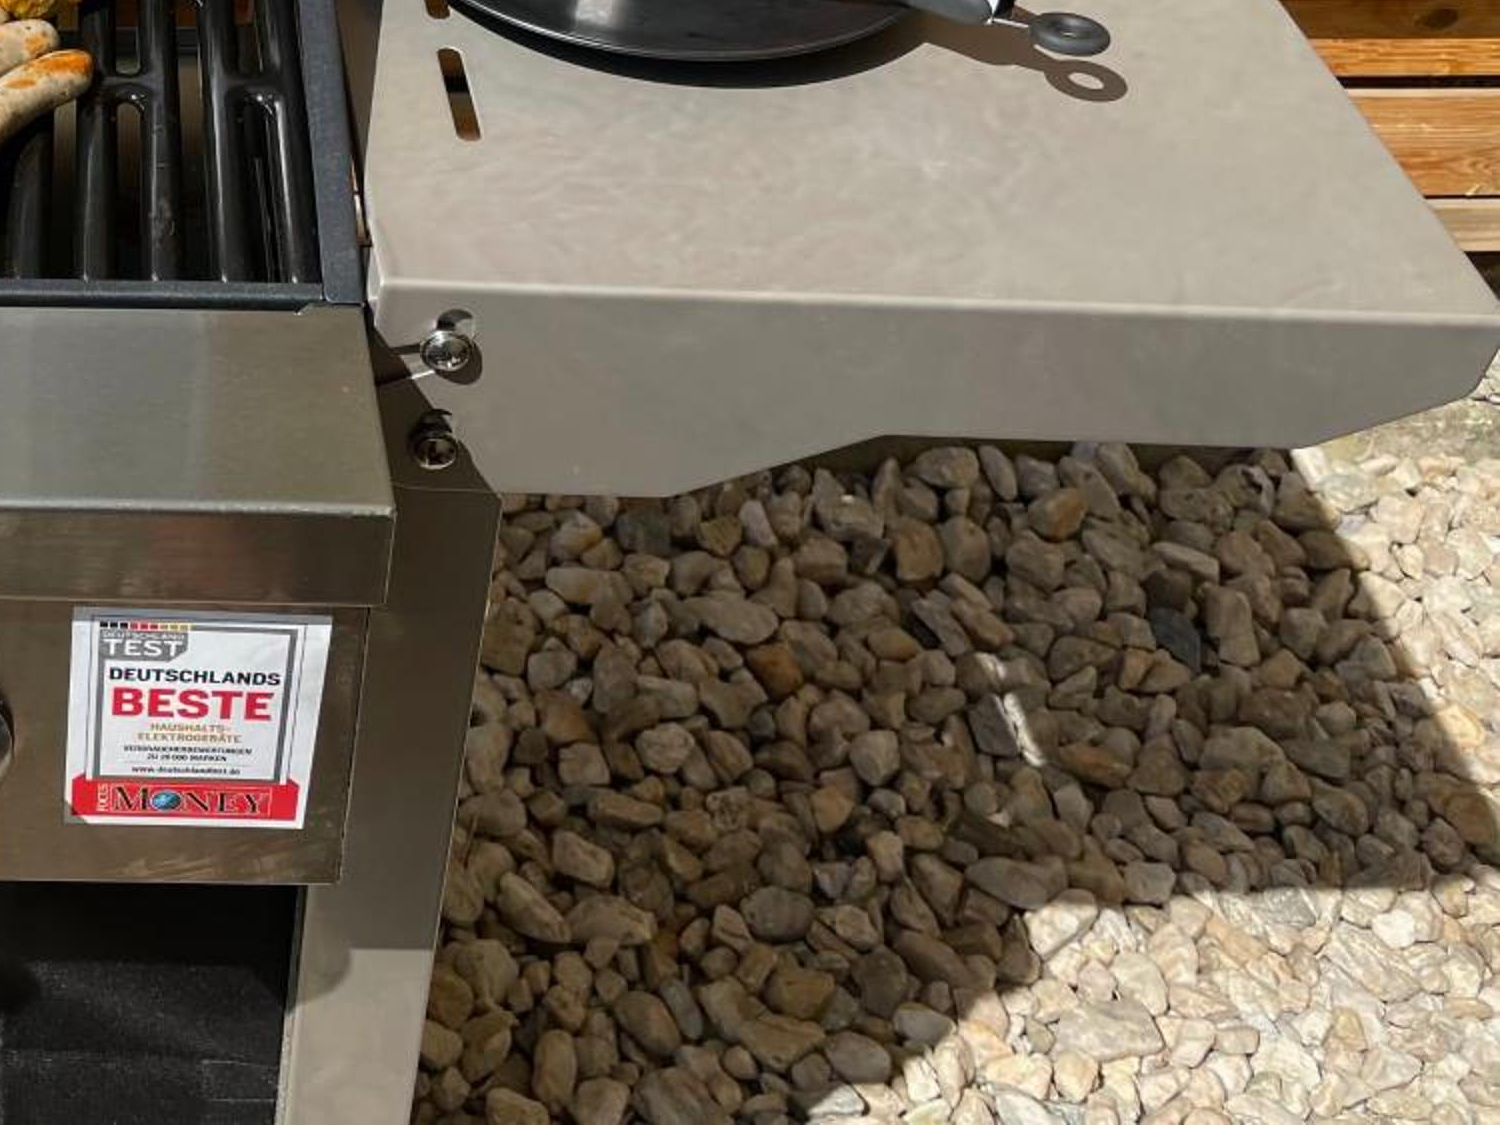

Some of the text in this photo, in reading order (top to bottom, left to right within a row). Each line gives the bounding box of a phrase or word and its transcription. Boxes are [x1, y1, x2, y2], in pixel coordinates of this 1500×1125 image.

[103, 639, 183, 657] TEST
[108, 667, 281, 686] DEUTSCHLANDS
[111, 687, 275, 721] BESTE
[112, 785, 267, 813] MONEY
